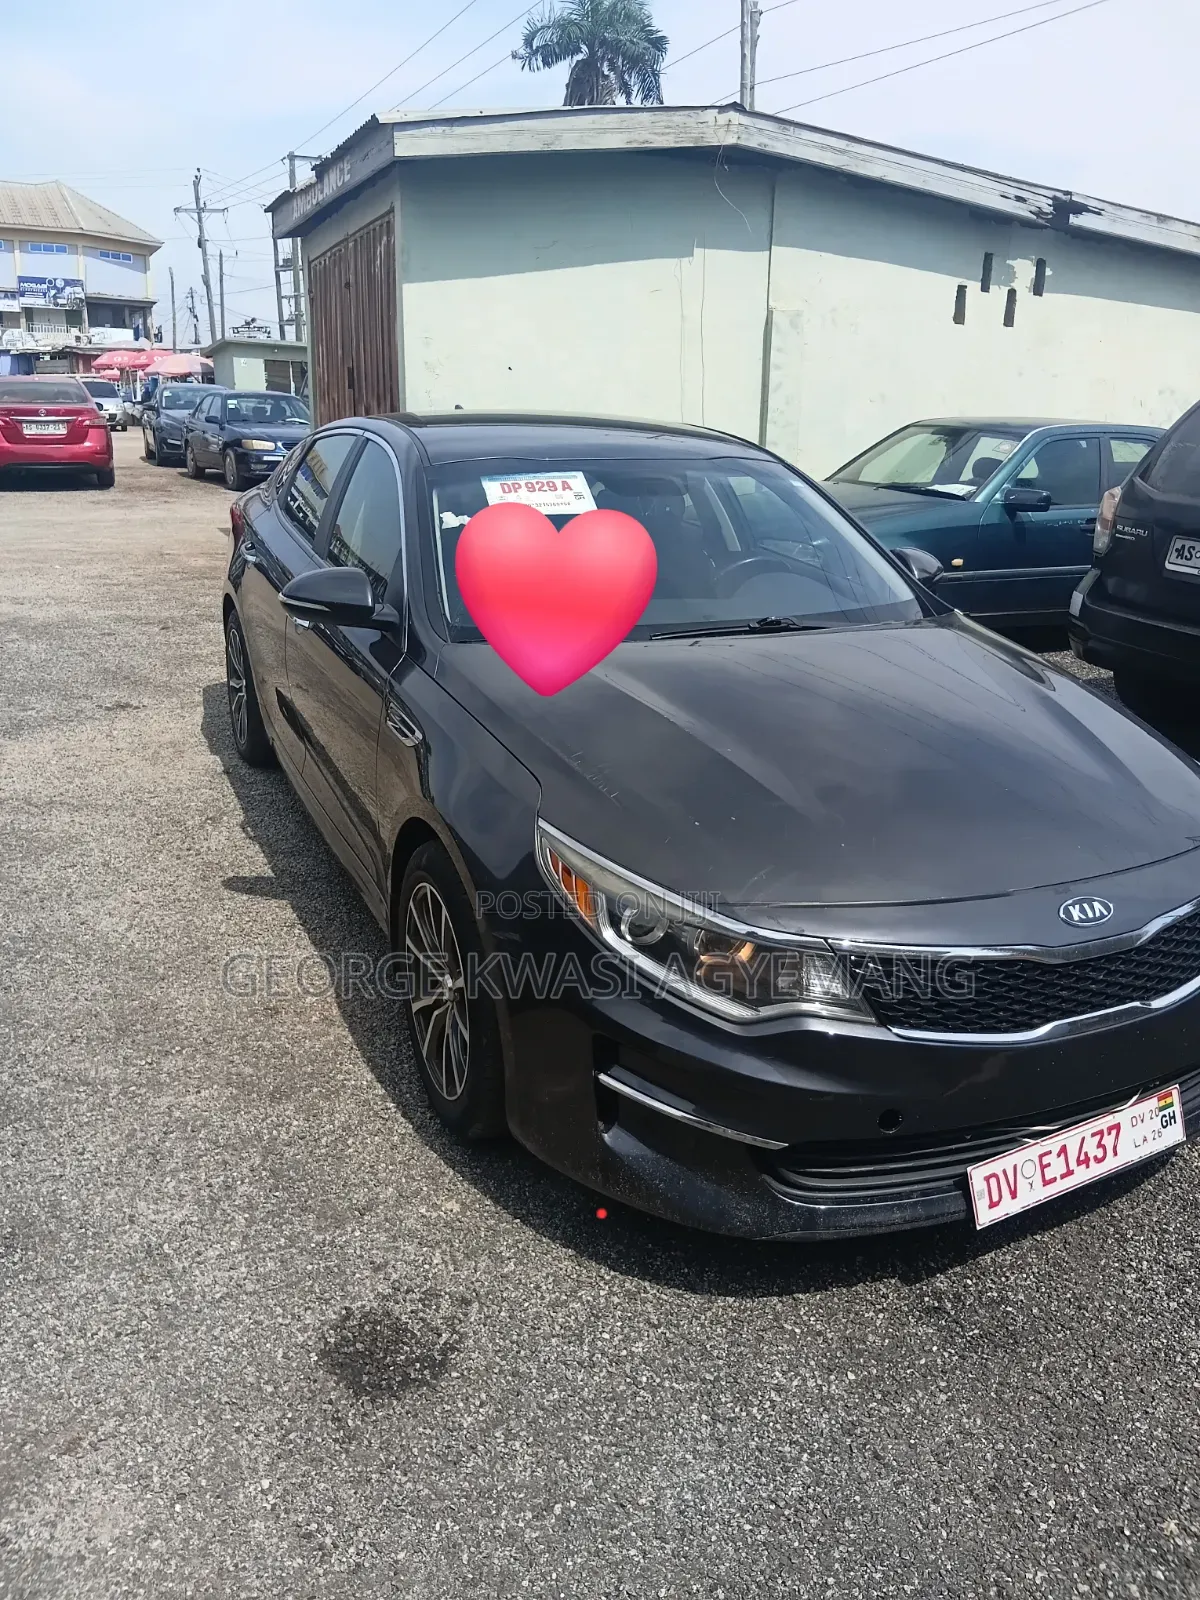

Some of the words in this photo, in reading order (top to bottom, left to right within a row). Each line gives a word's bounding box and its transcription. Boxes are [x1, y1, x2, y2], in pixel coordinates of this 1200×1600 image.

[292, 155, 351, 220] AMBULANCE
[500, 482, 522, 494] DP
[525, 480, 558, 493] 929
[562, 480, 573, 491] A
[1116, 524, 1148, 536] SUBARU
[1067, 901, 1109, 921] KIA
[1160, 1109, 1177, 1129] GH
[983, 1163, 1019, 1210] DV
[1038, 1122, 1122, 1187] E1437
